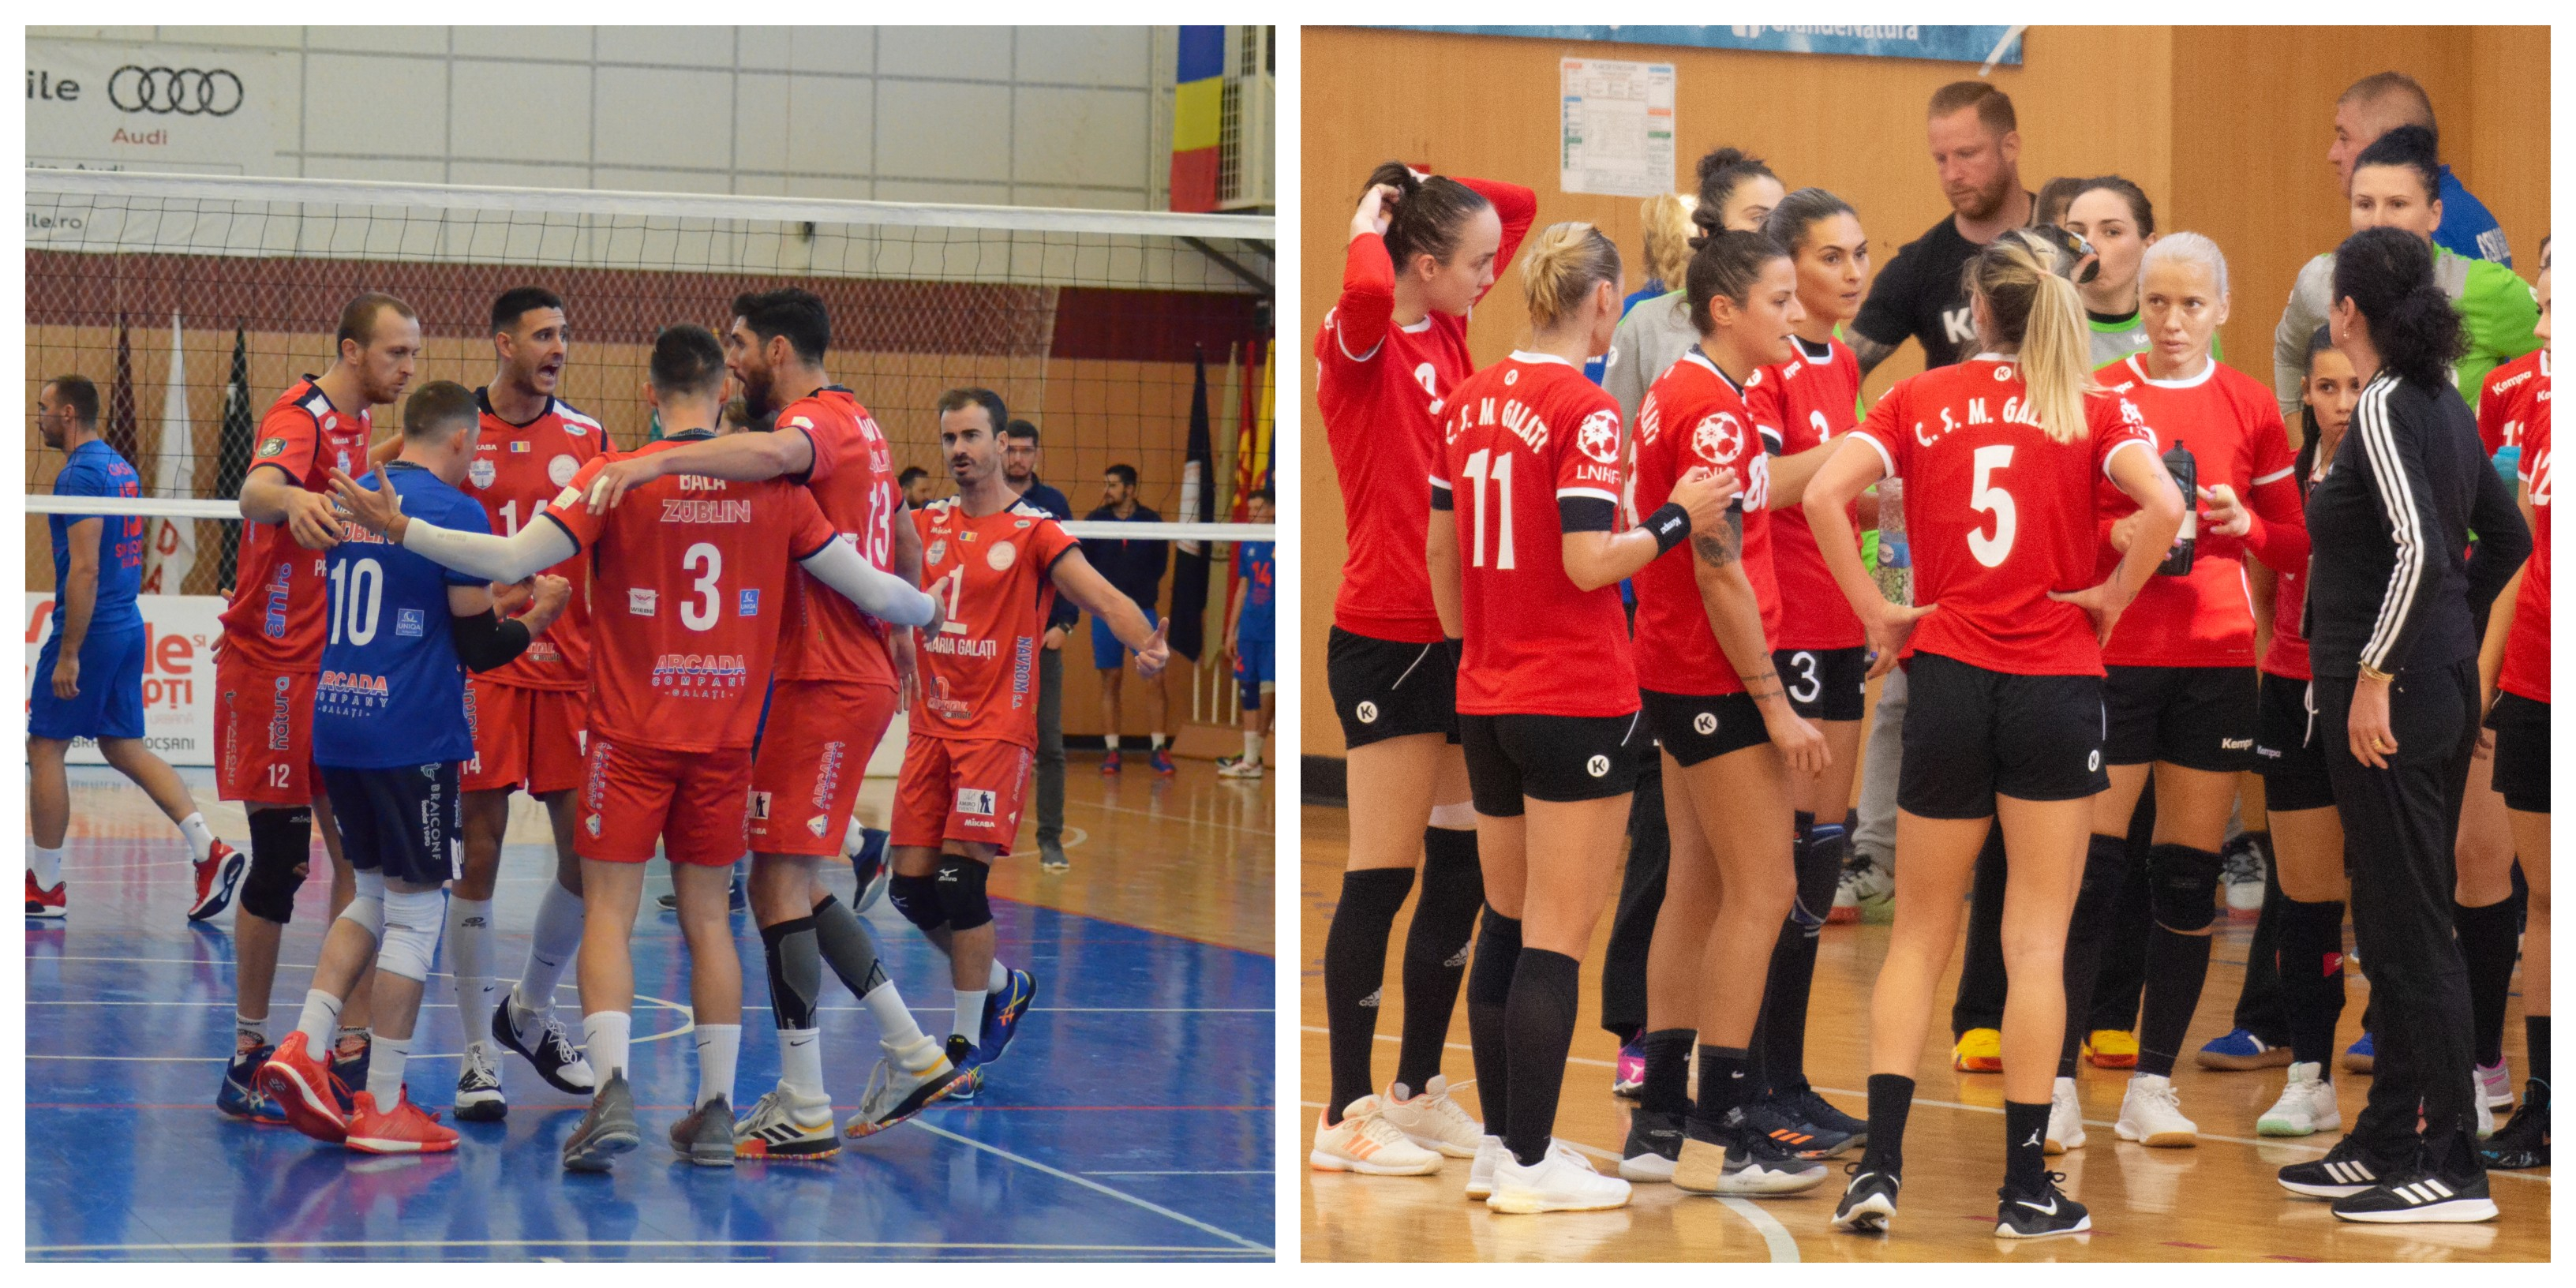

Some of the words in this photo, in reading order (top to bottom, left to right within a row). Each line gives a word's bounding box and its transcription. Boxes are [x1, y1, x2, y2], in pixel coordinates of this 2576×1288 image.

[112, 127, 168, 145] Audi
[2492, 370, 2533, 396] Kempa
[1460, 403, 1473, 432] S.
[1501, 399, 1549, 455] GALATI
[1915, 421, 1938, 447] C.
[1940, 406, 1961, 433] S.
[1968, 397, 1994, 425] M.
[2528, 448, 2551, 506] 12
[660, 498, 751, 524] ZÜBLIN
[866, 480, 892, 567] 13
[1462, 447, 1515, 570] 11
[1967, 444, 2016, 568] 5
[264, 562, 292, 638] amiro
[330, 557, 384, 646] 10
[631, 606, 654, 615] WIEBE
[680, 541, 722, 632] 3
[948, 564, 965, 621] 1
[397, 622, 422, 631] UNIQA
[957, 638, 997, 661] GALAȚI
[652, 676, 747, 687] COMPANY
[653, 653, 747, 676] ARCADA
[1013, 635, 1033, 694] NAVROM
[1788, 650, 1822, 703] 3
[273, 676, 290, 751] natura
[672, 690, 726, 700] GALAȚI
[144, 736, 195, 752] OCȘANI
[462, 751, 481, 775] 14
[268, 763, 290, 788] 12
[812, 741, 839, 809] ARCADA
[429, 784, 441, 860] BRAICONF
